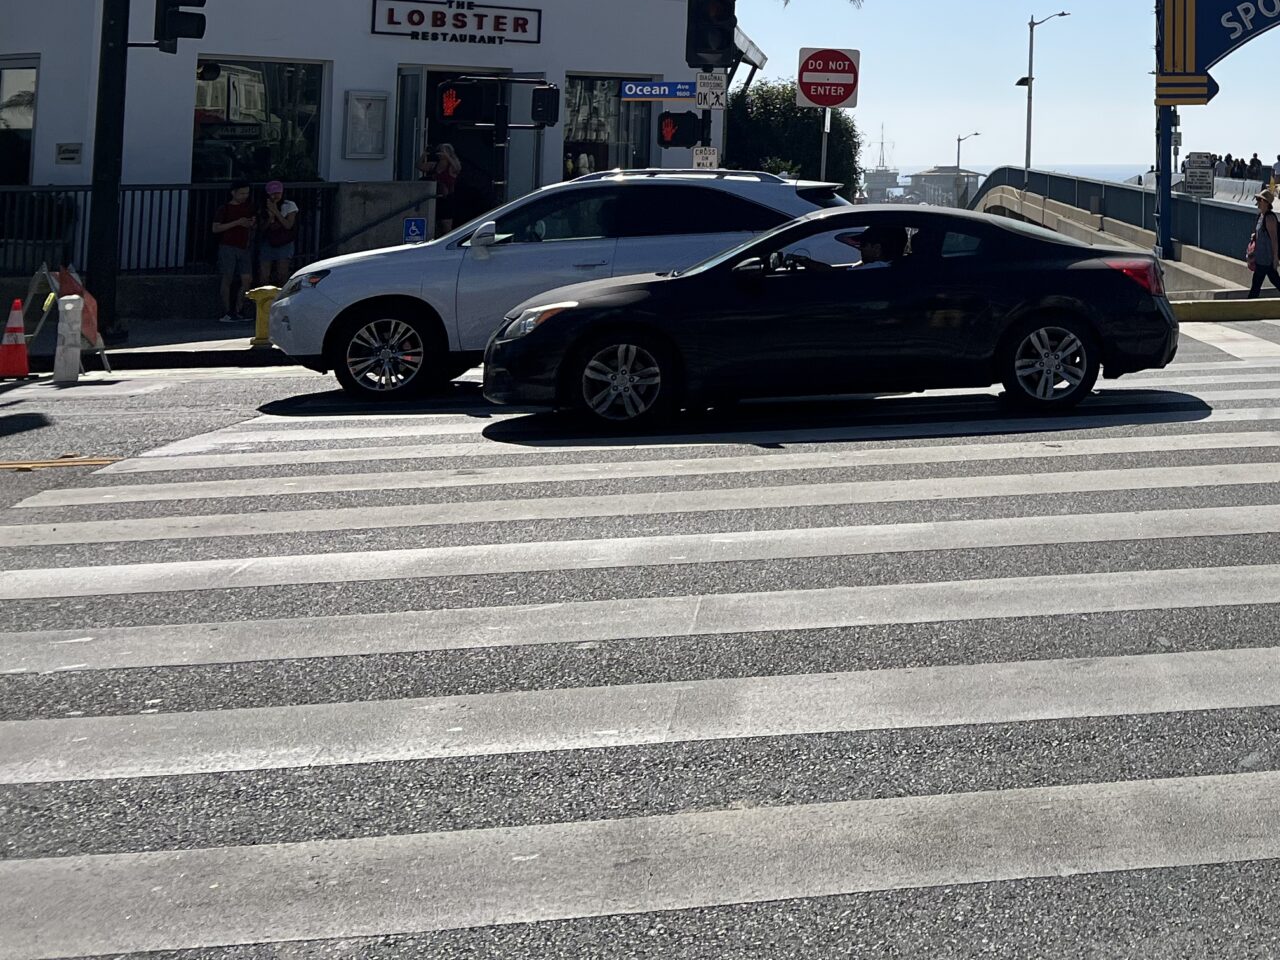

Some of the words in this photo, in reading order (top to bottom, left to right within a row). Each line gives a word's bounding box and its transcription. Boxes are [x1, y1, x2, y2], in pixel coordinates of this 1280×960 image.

[446, 0, 475, 10] THE
[387, 7, 529, 34] LOBSTER
[410, 30, 506, 45] RESTAURANT
[808, 60, 823, 70] DO
[828, 61, 850, 71] NOT
[625, 83, 669, 95] Ocean
[810, 85, 845, 96] ENTER
[697, 91, 709, 106] OK
[695, 147, 716, 156] CROSS
